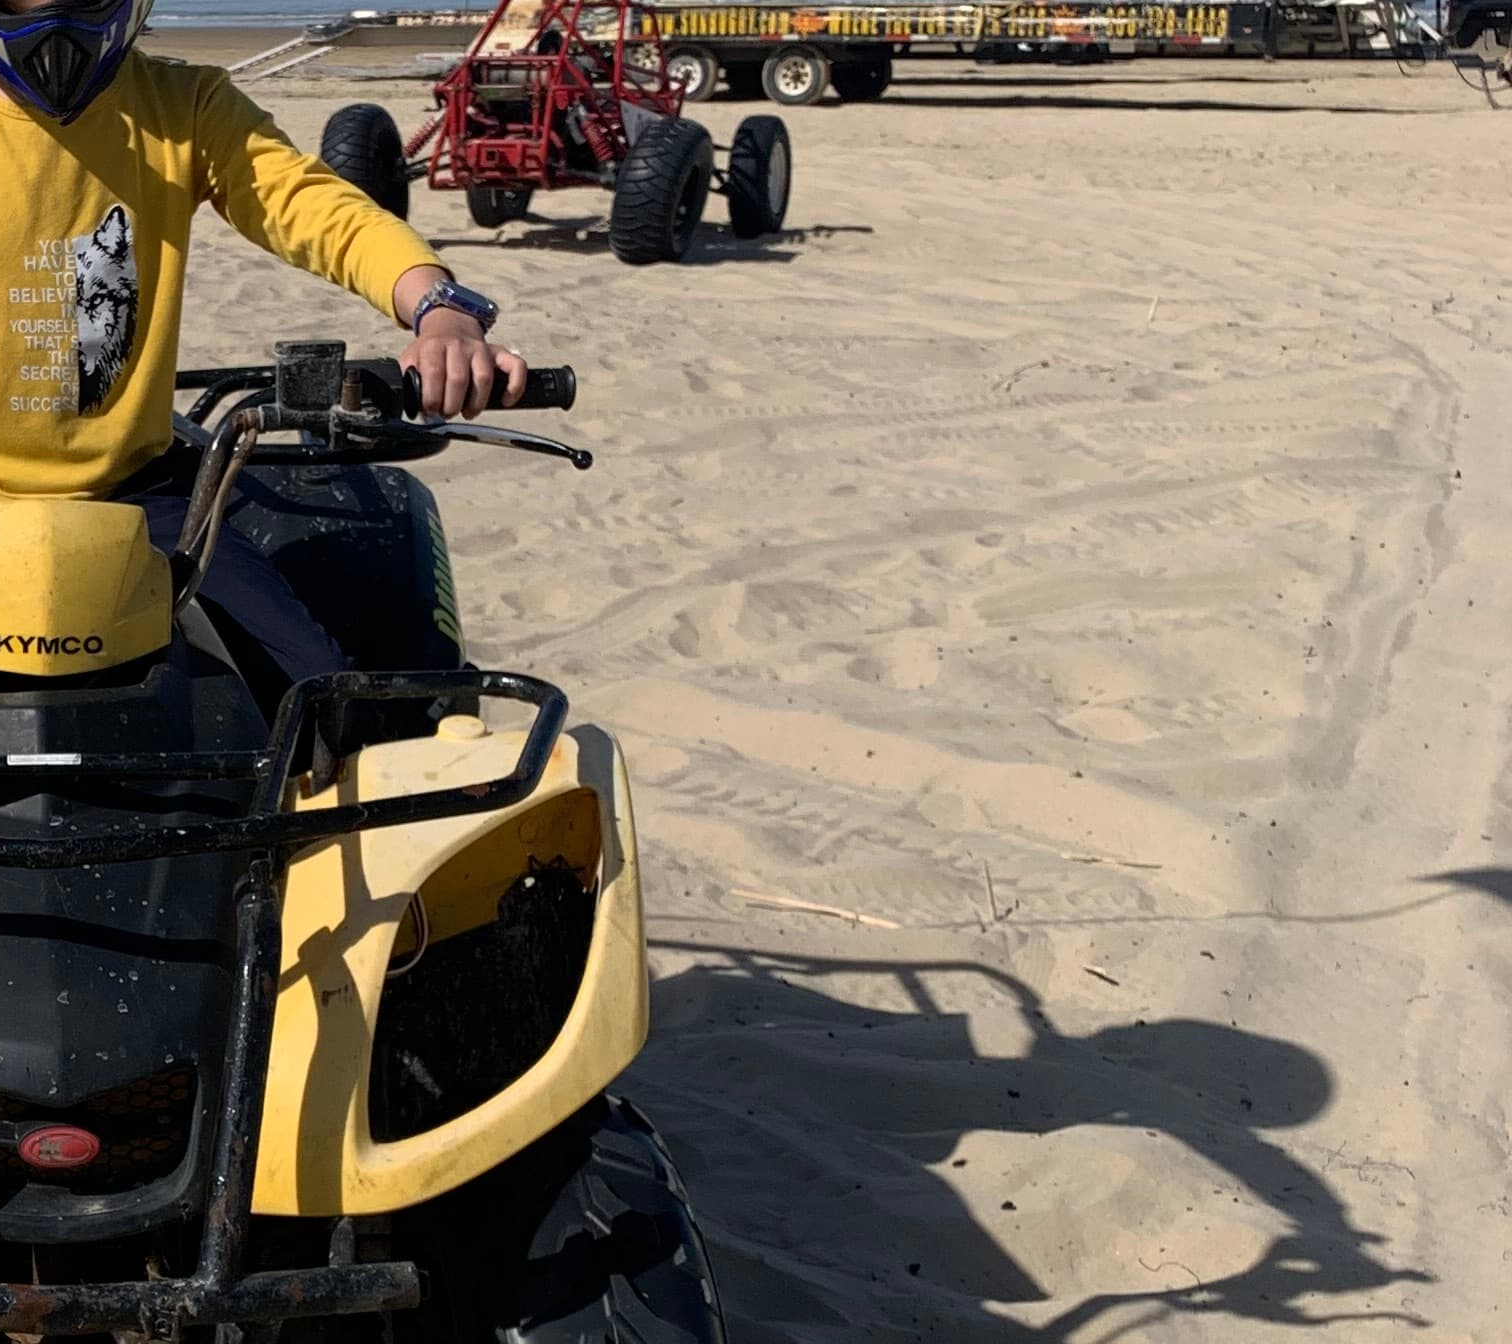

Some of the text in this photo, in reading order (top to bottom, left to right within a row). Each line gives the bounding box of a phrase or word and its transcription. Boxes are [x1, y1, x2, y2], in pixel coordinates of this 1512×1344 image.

[39, 238, 76, 255] YOU
[23, 255, 77, 271] HAVE
[52, 271, 77, 287] TO
[9, 319, 78, 334] YOURSELF
[24, 335, 79, 350] THAT'S
[20, 366, 79, 381] SECRET
[60, 381, 79, 396] OF
[9, 396, 79, 412] SUCCESS
